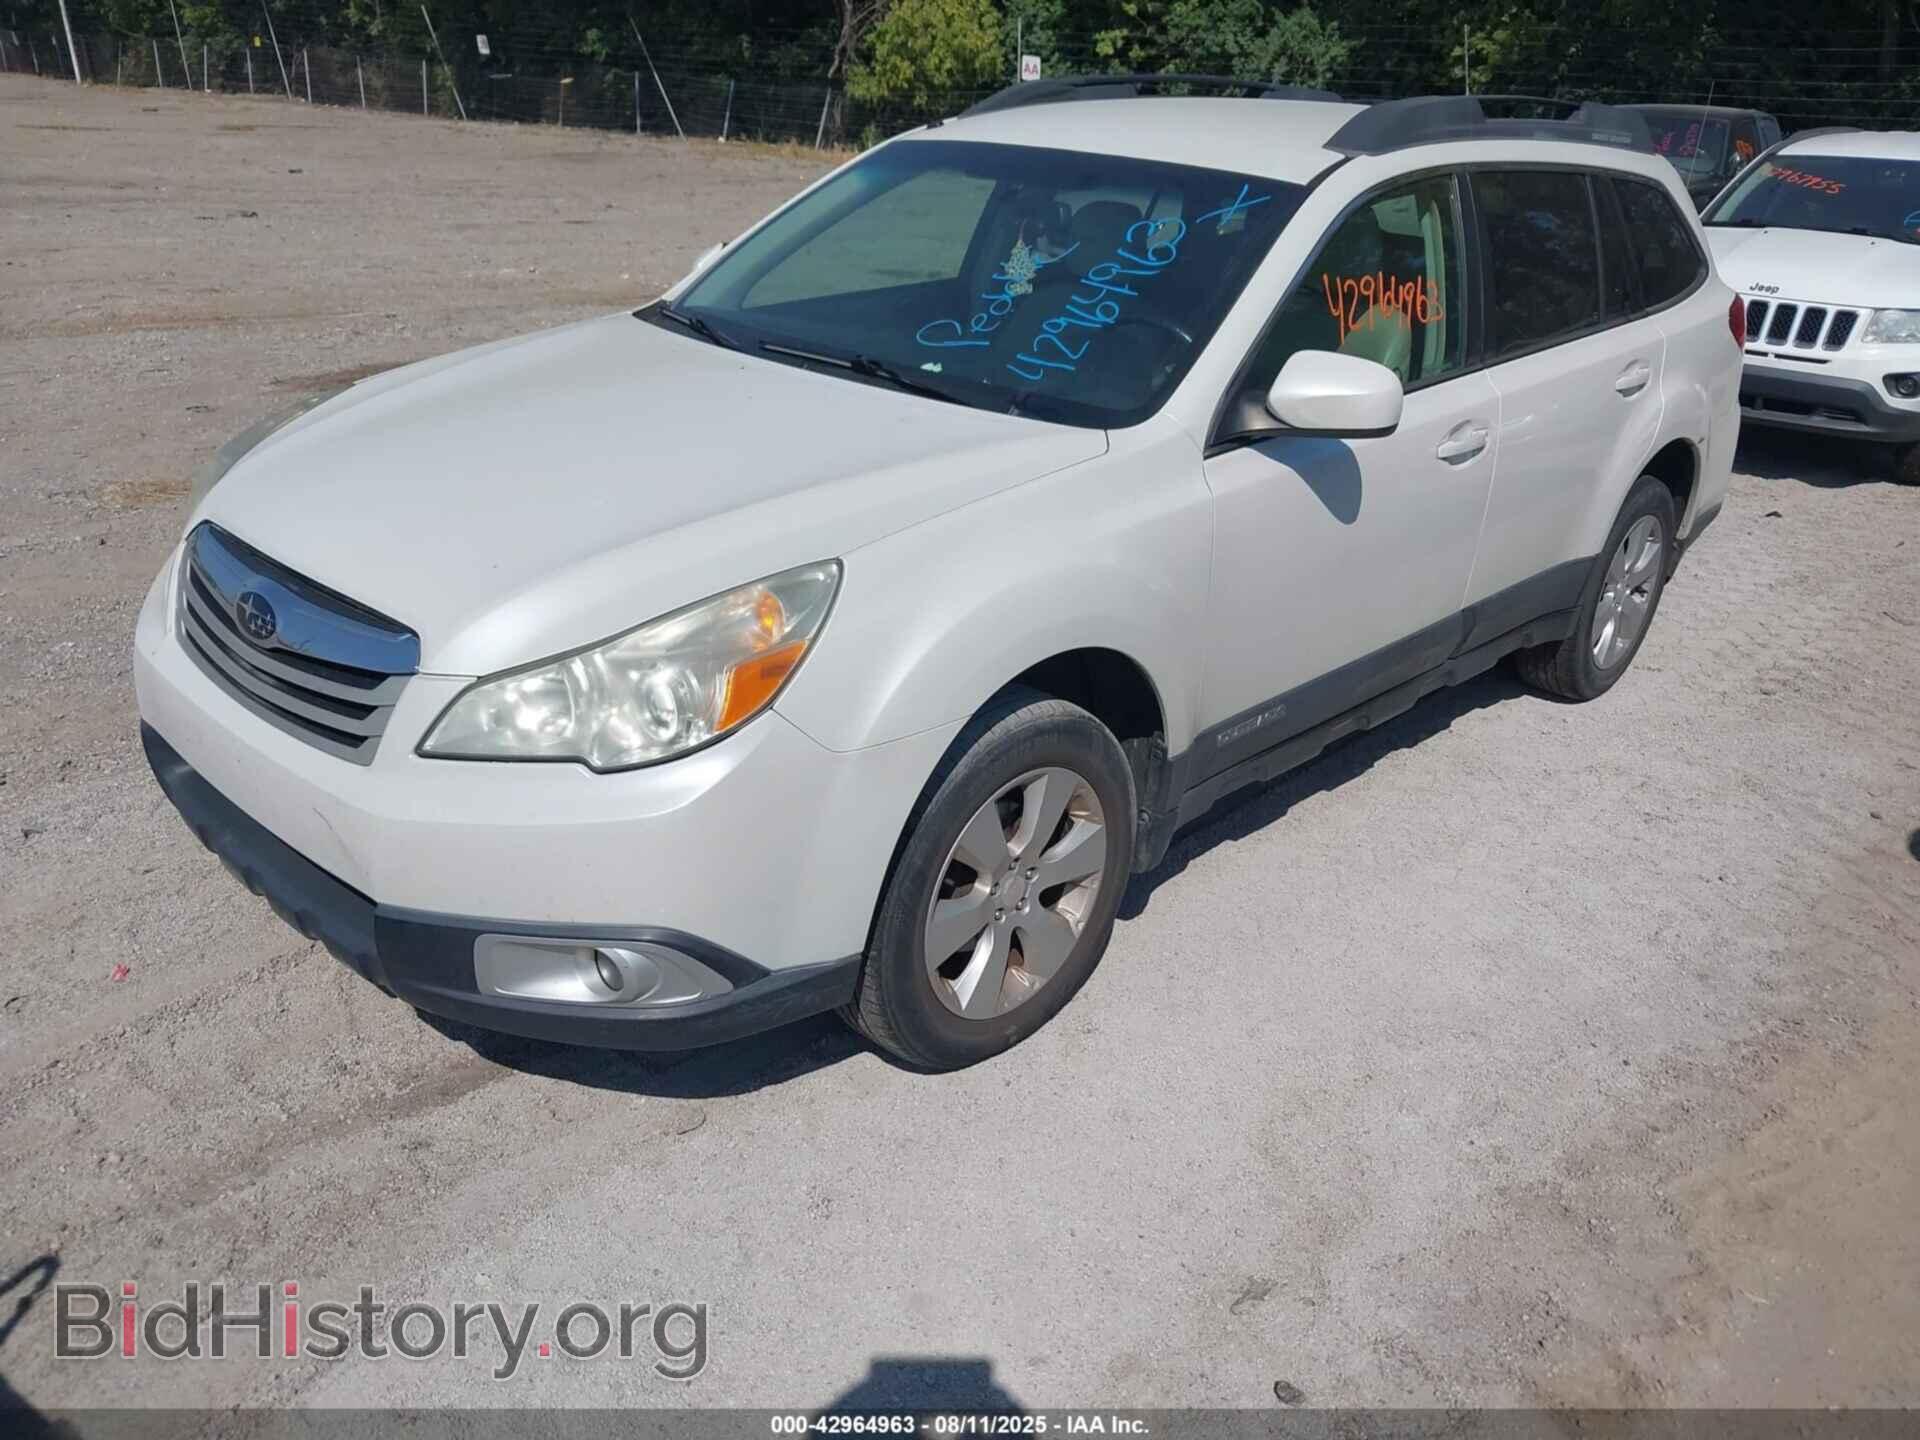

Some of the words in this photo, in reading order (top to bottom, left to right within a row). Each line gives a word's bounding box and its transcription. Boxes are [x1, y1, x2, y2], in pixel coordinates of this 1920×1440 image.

[1007, 218, 1186, 380] 42964963
[1322, 271, 1444, 345] 42964963
[1749, 282, 1780, 295] Jeep
